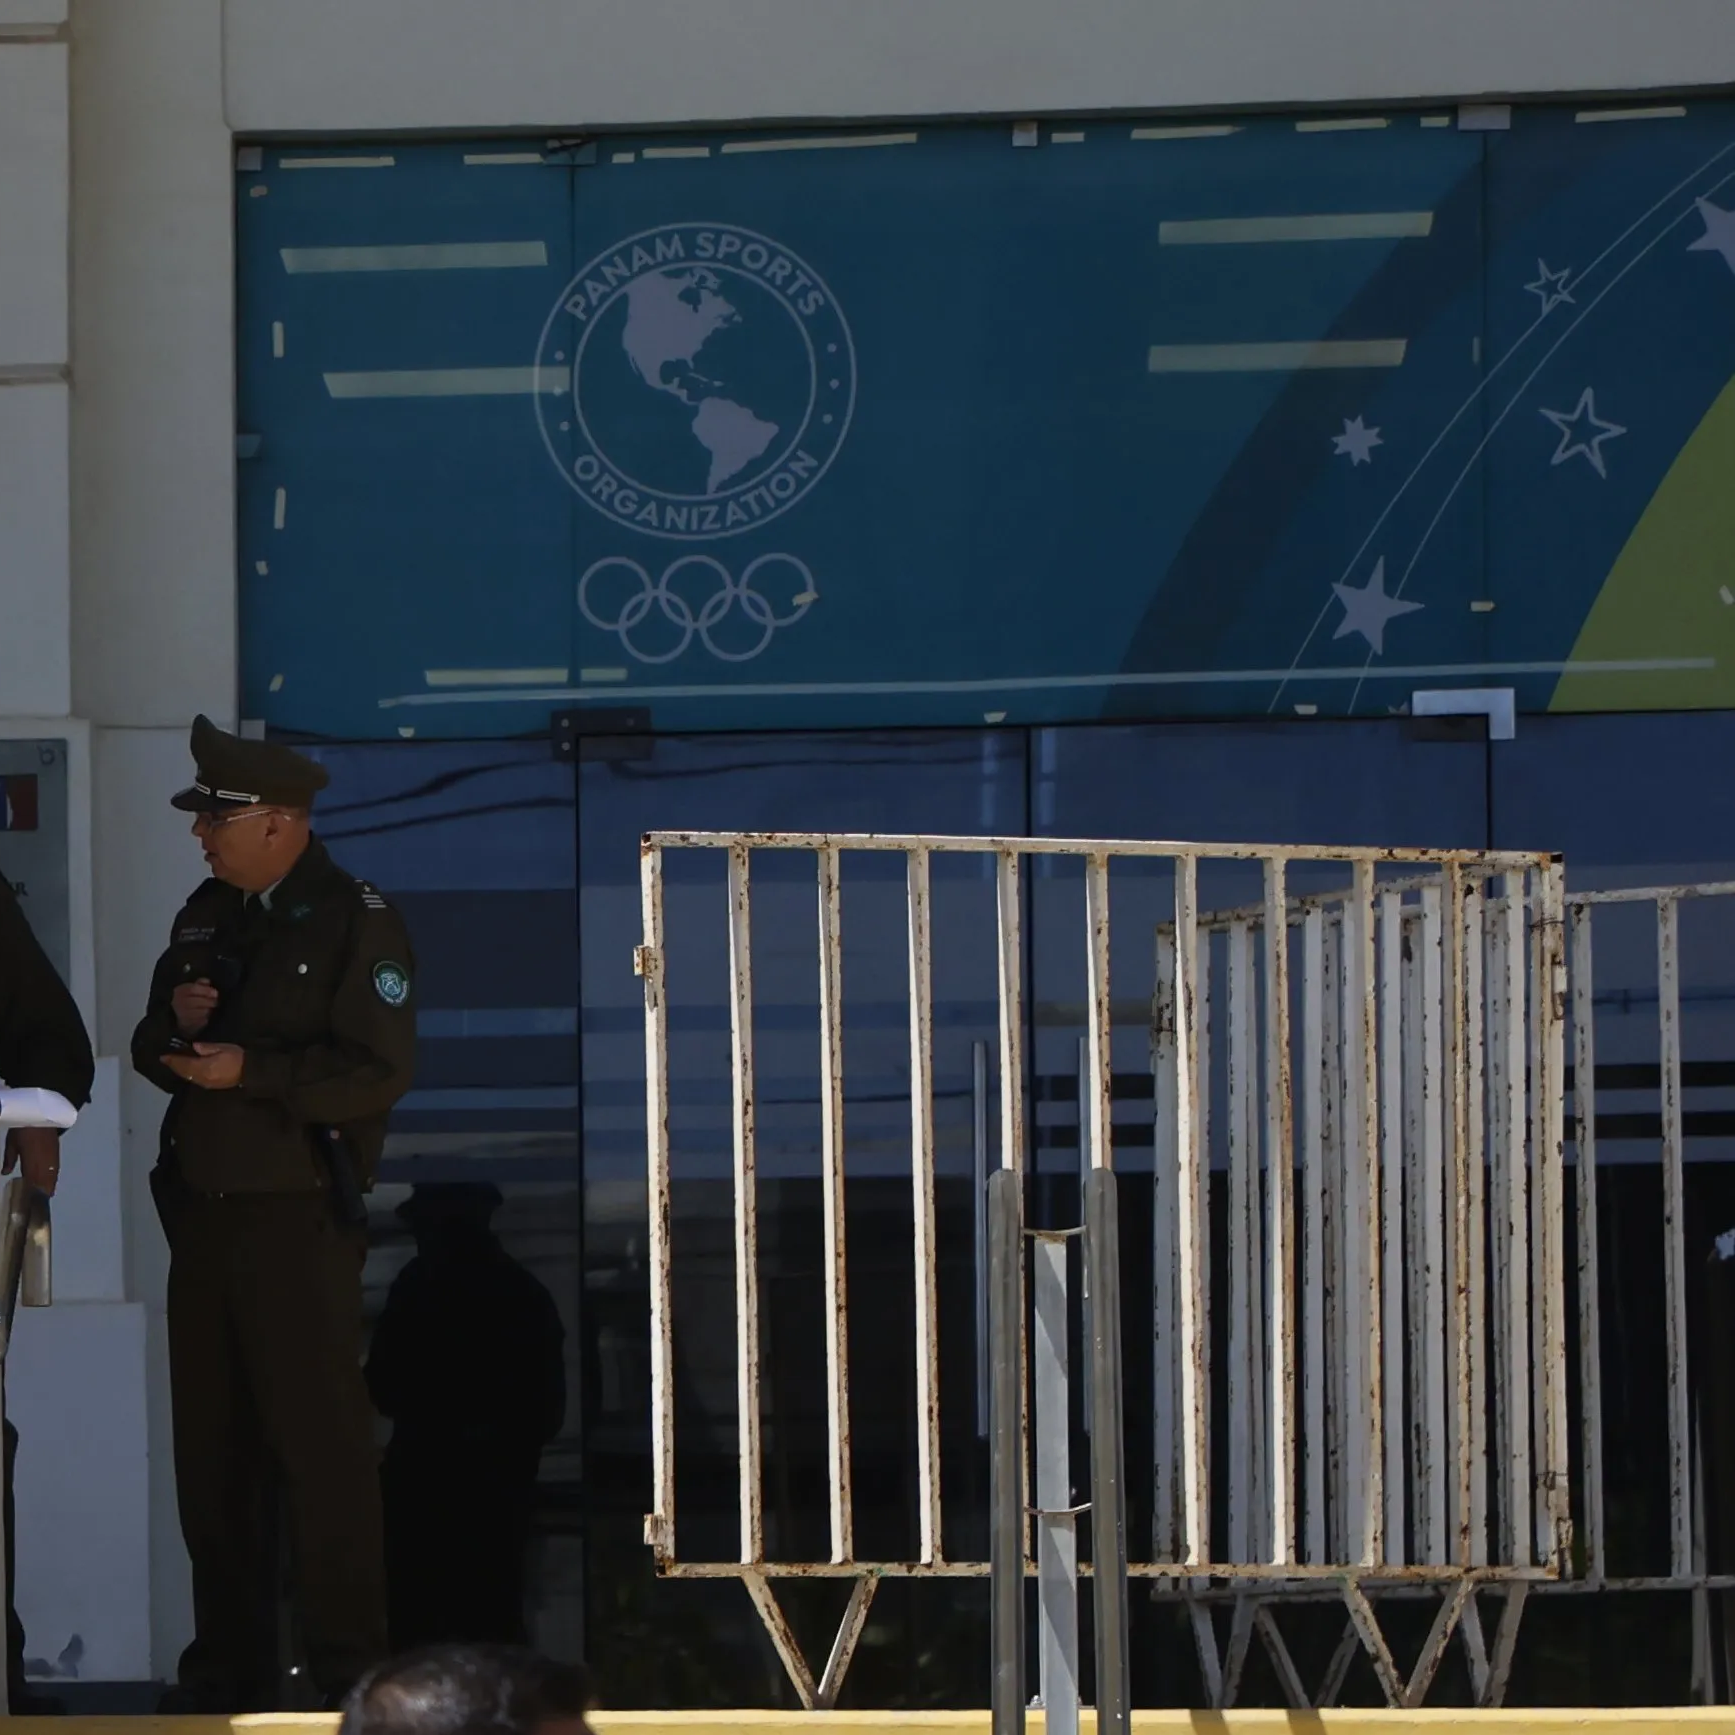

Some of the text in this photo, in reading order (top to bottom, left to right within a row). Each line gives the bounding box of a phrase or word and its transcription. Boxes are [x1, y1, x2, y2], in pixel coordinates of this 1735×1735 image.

[564, 231, 826, 322] PANAM SPORTS
[573, 449, 819, 532] ORGANIZATION
